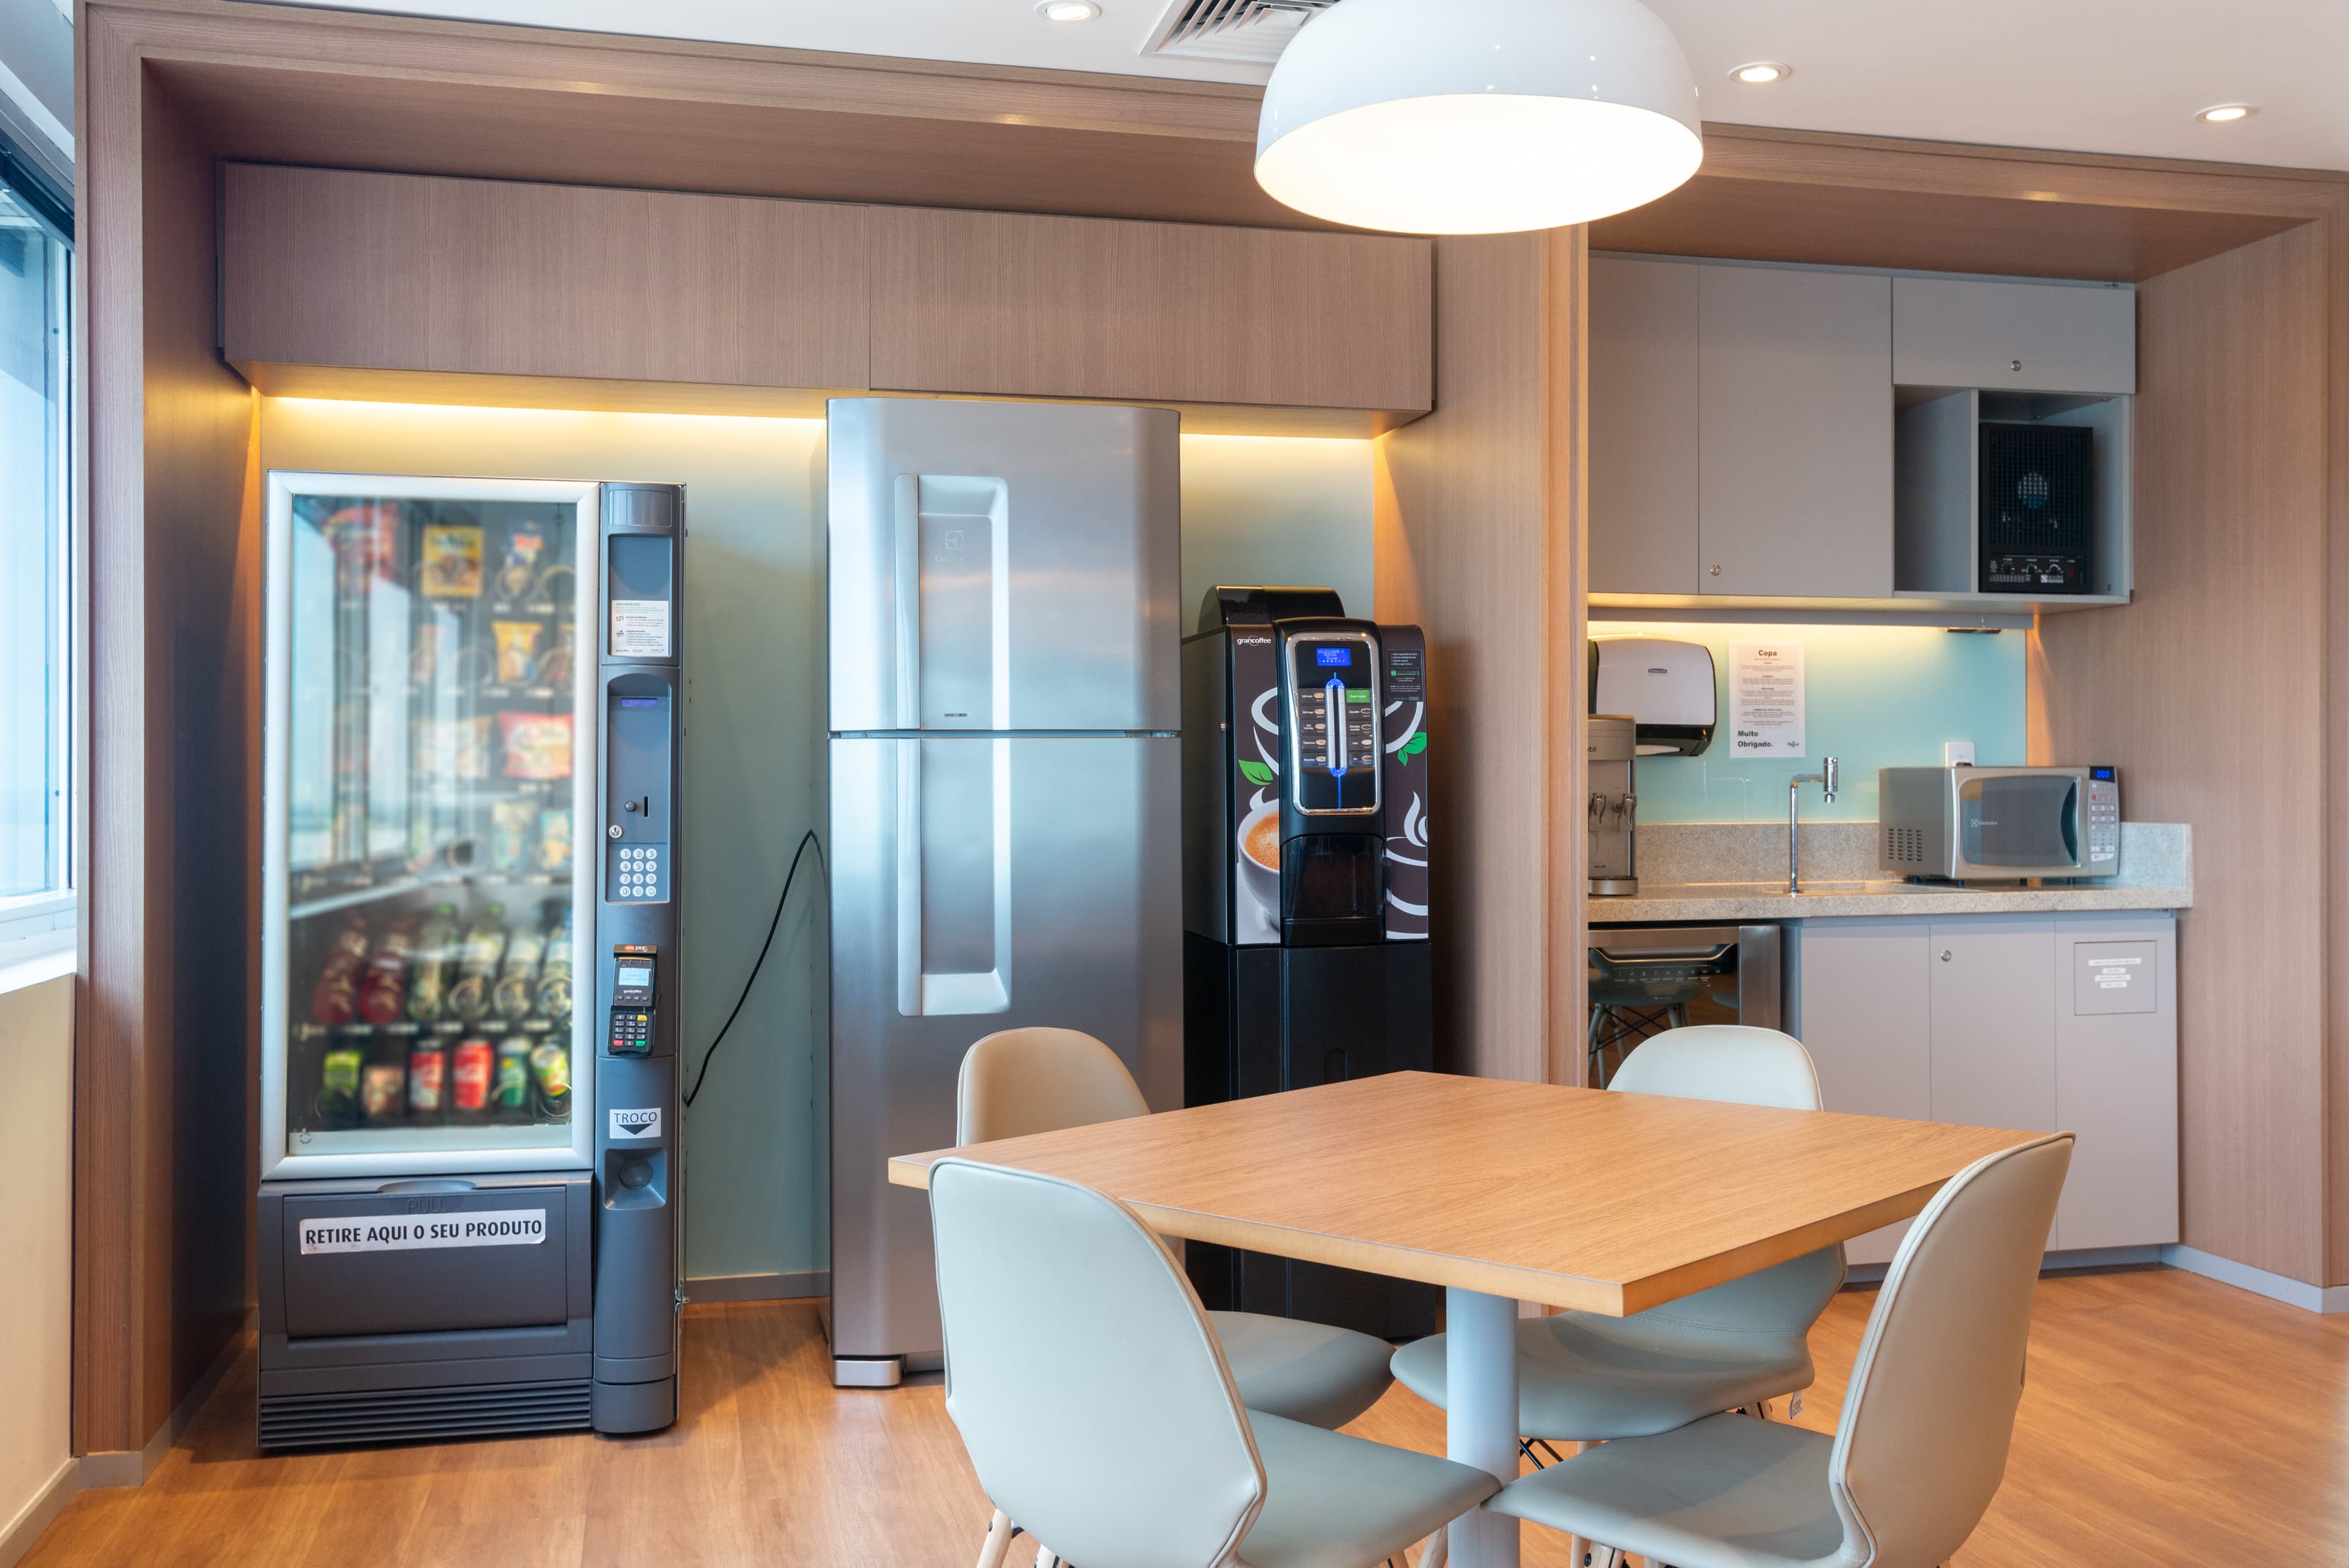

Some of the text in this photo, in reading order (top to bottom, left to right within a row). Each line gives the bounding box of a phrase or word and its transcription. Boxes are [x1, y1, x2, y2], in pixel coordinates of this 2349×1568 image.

[614, 1111, 657, 1123] TROCO
[408, 1198, 447, 1213] PULL
[306, 1220, 542, 1244] RETIRE AQUI O SEU PRODUTO
